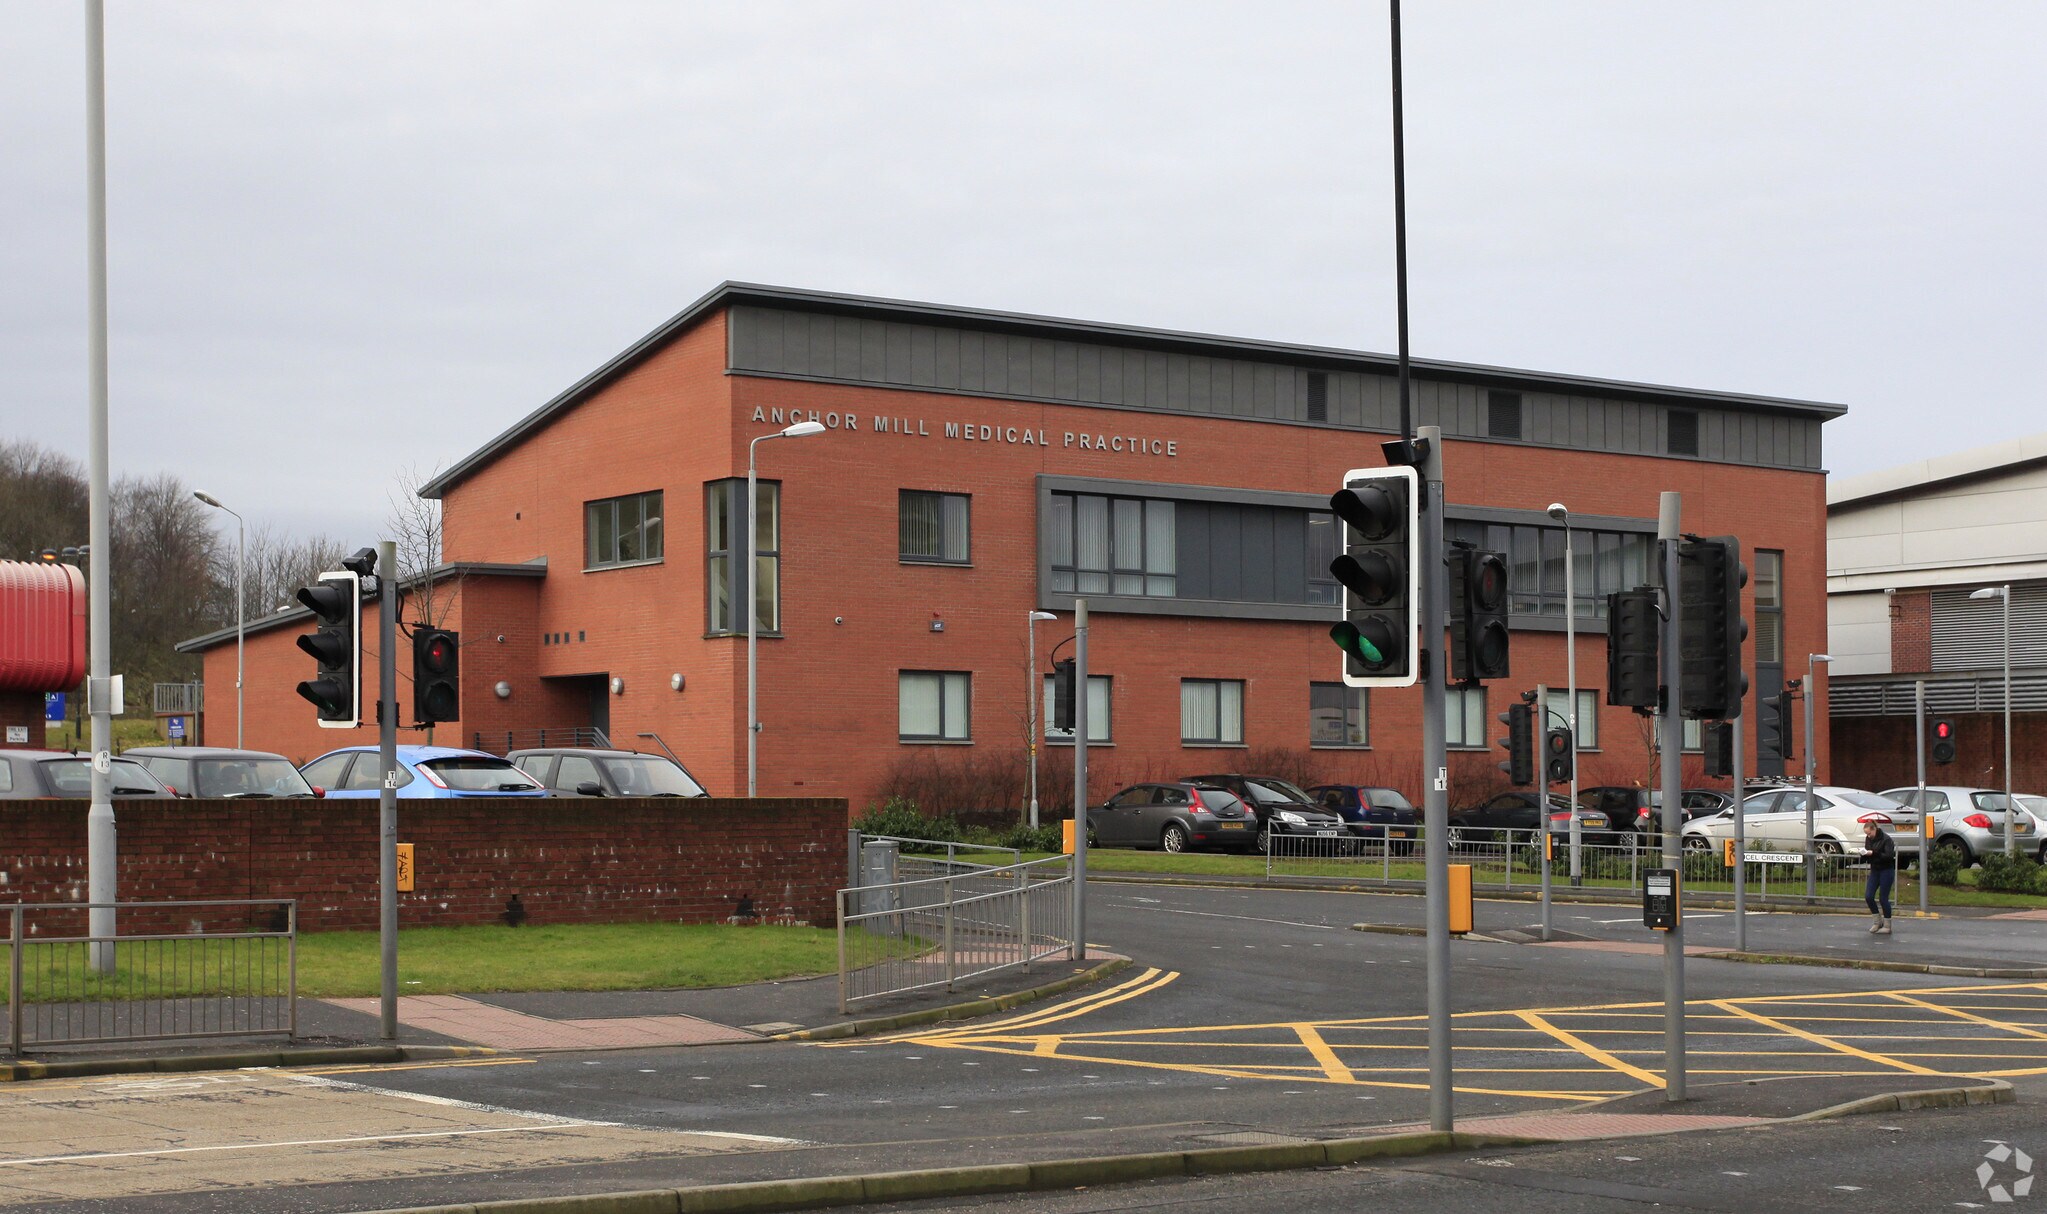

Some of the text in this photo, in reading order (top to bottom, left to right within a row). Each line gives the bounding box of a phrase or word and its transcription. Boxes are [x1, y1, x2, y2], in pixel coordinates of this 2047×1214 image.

[752, 406, 1177, 456] ANCHOR MILL MEDICAL PRACTICE
[1761, 854, 1799, 862] CRESCENT
